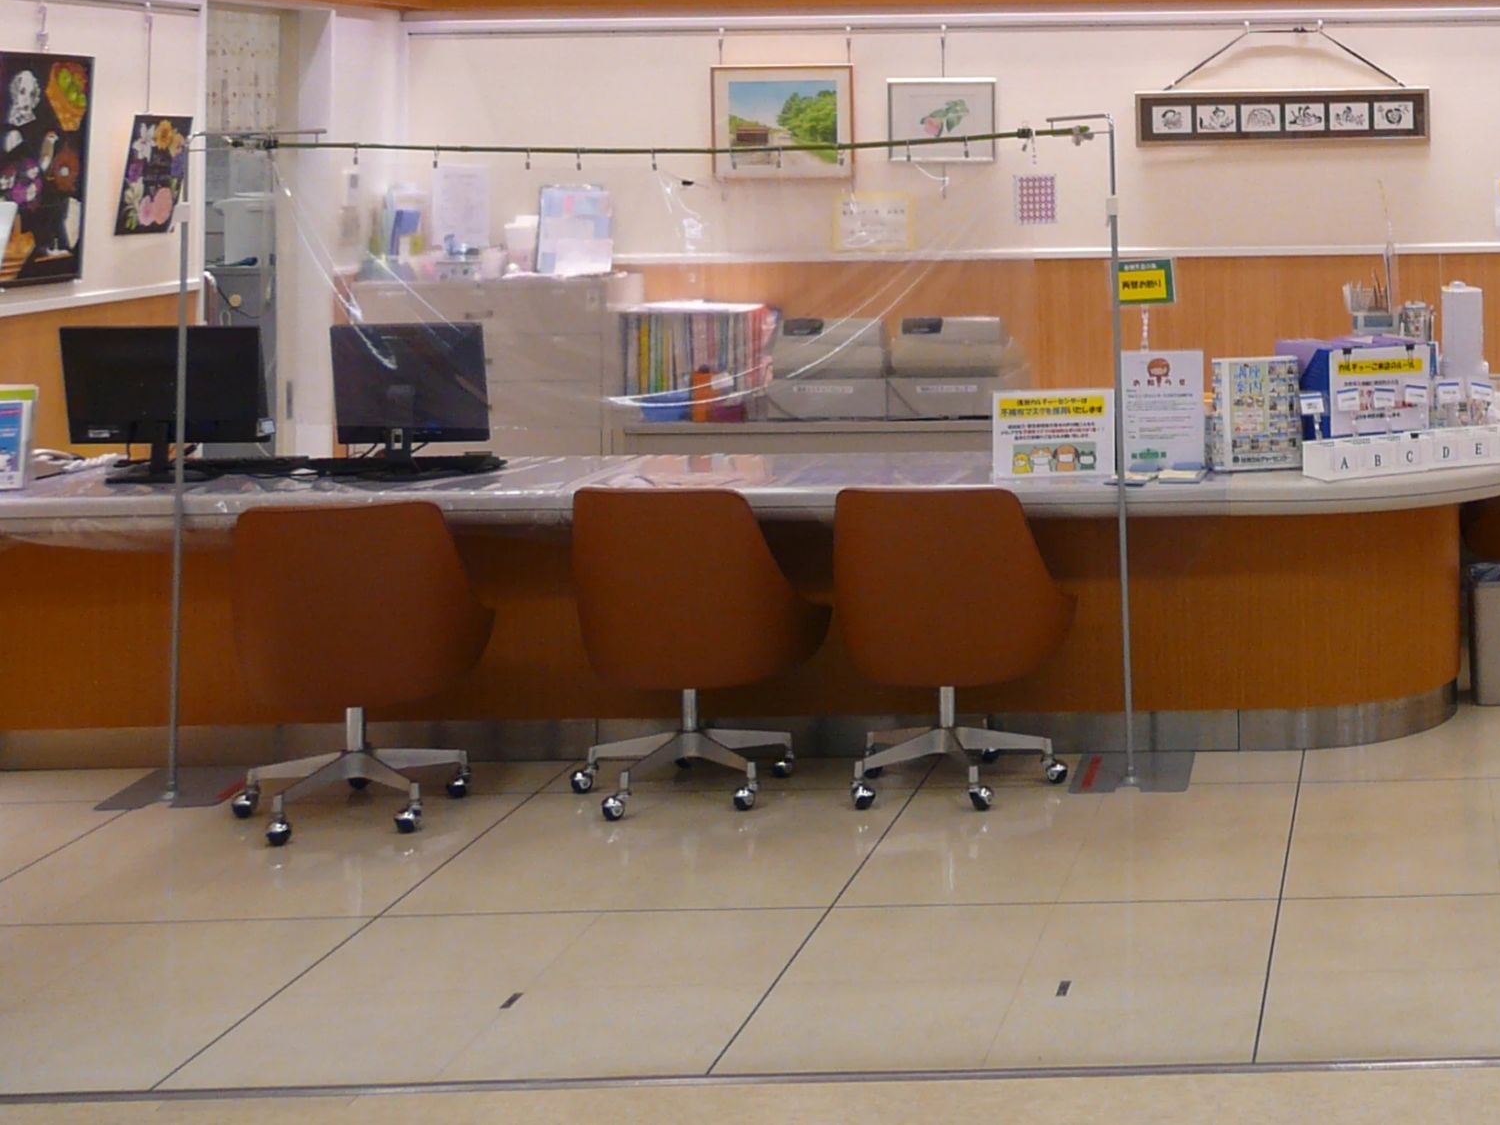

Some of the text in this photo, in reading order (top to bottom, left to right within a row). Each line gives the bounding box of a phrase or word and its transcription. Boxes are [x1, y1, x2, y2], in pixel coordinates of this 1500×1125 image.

[1442, 445, 1450, 459] D
[1475, 442, 1483, 455] E
[1340, 456, 1349, 470] A
[1374, 454, 1382, 467] B
[1406, 450, 1414, 463] C
